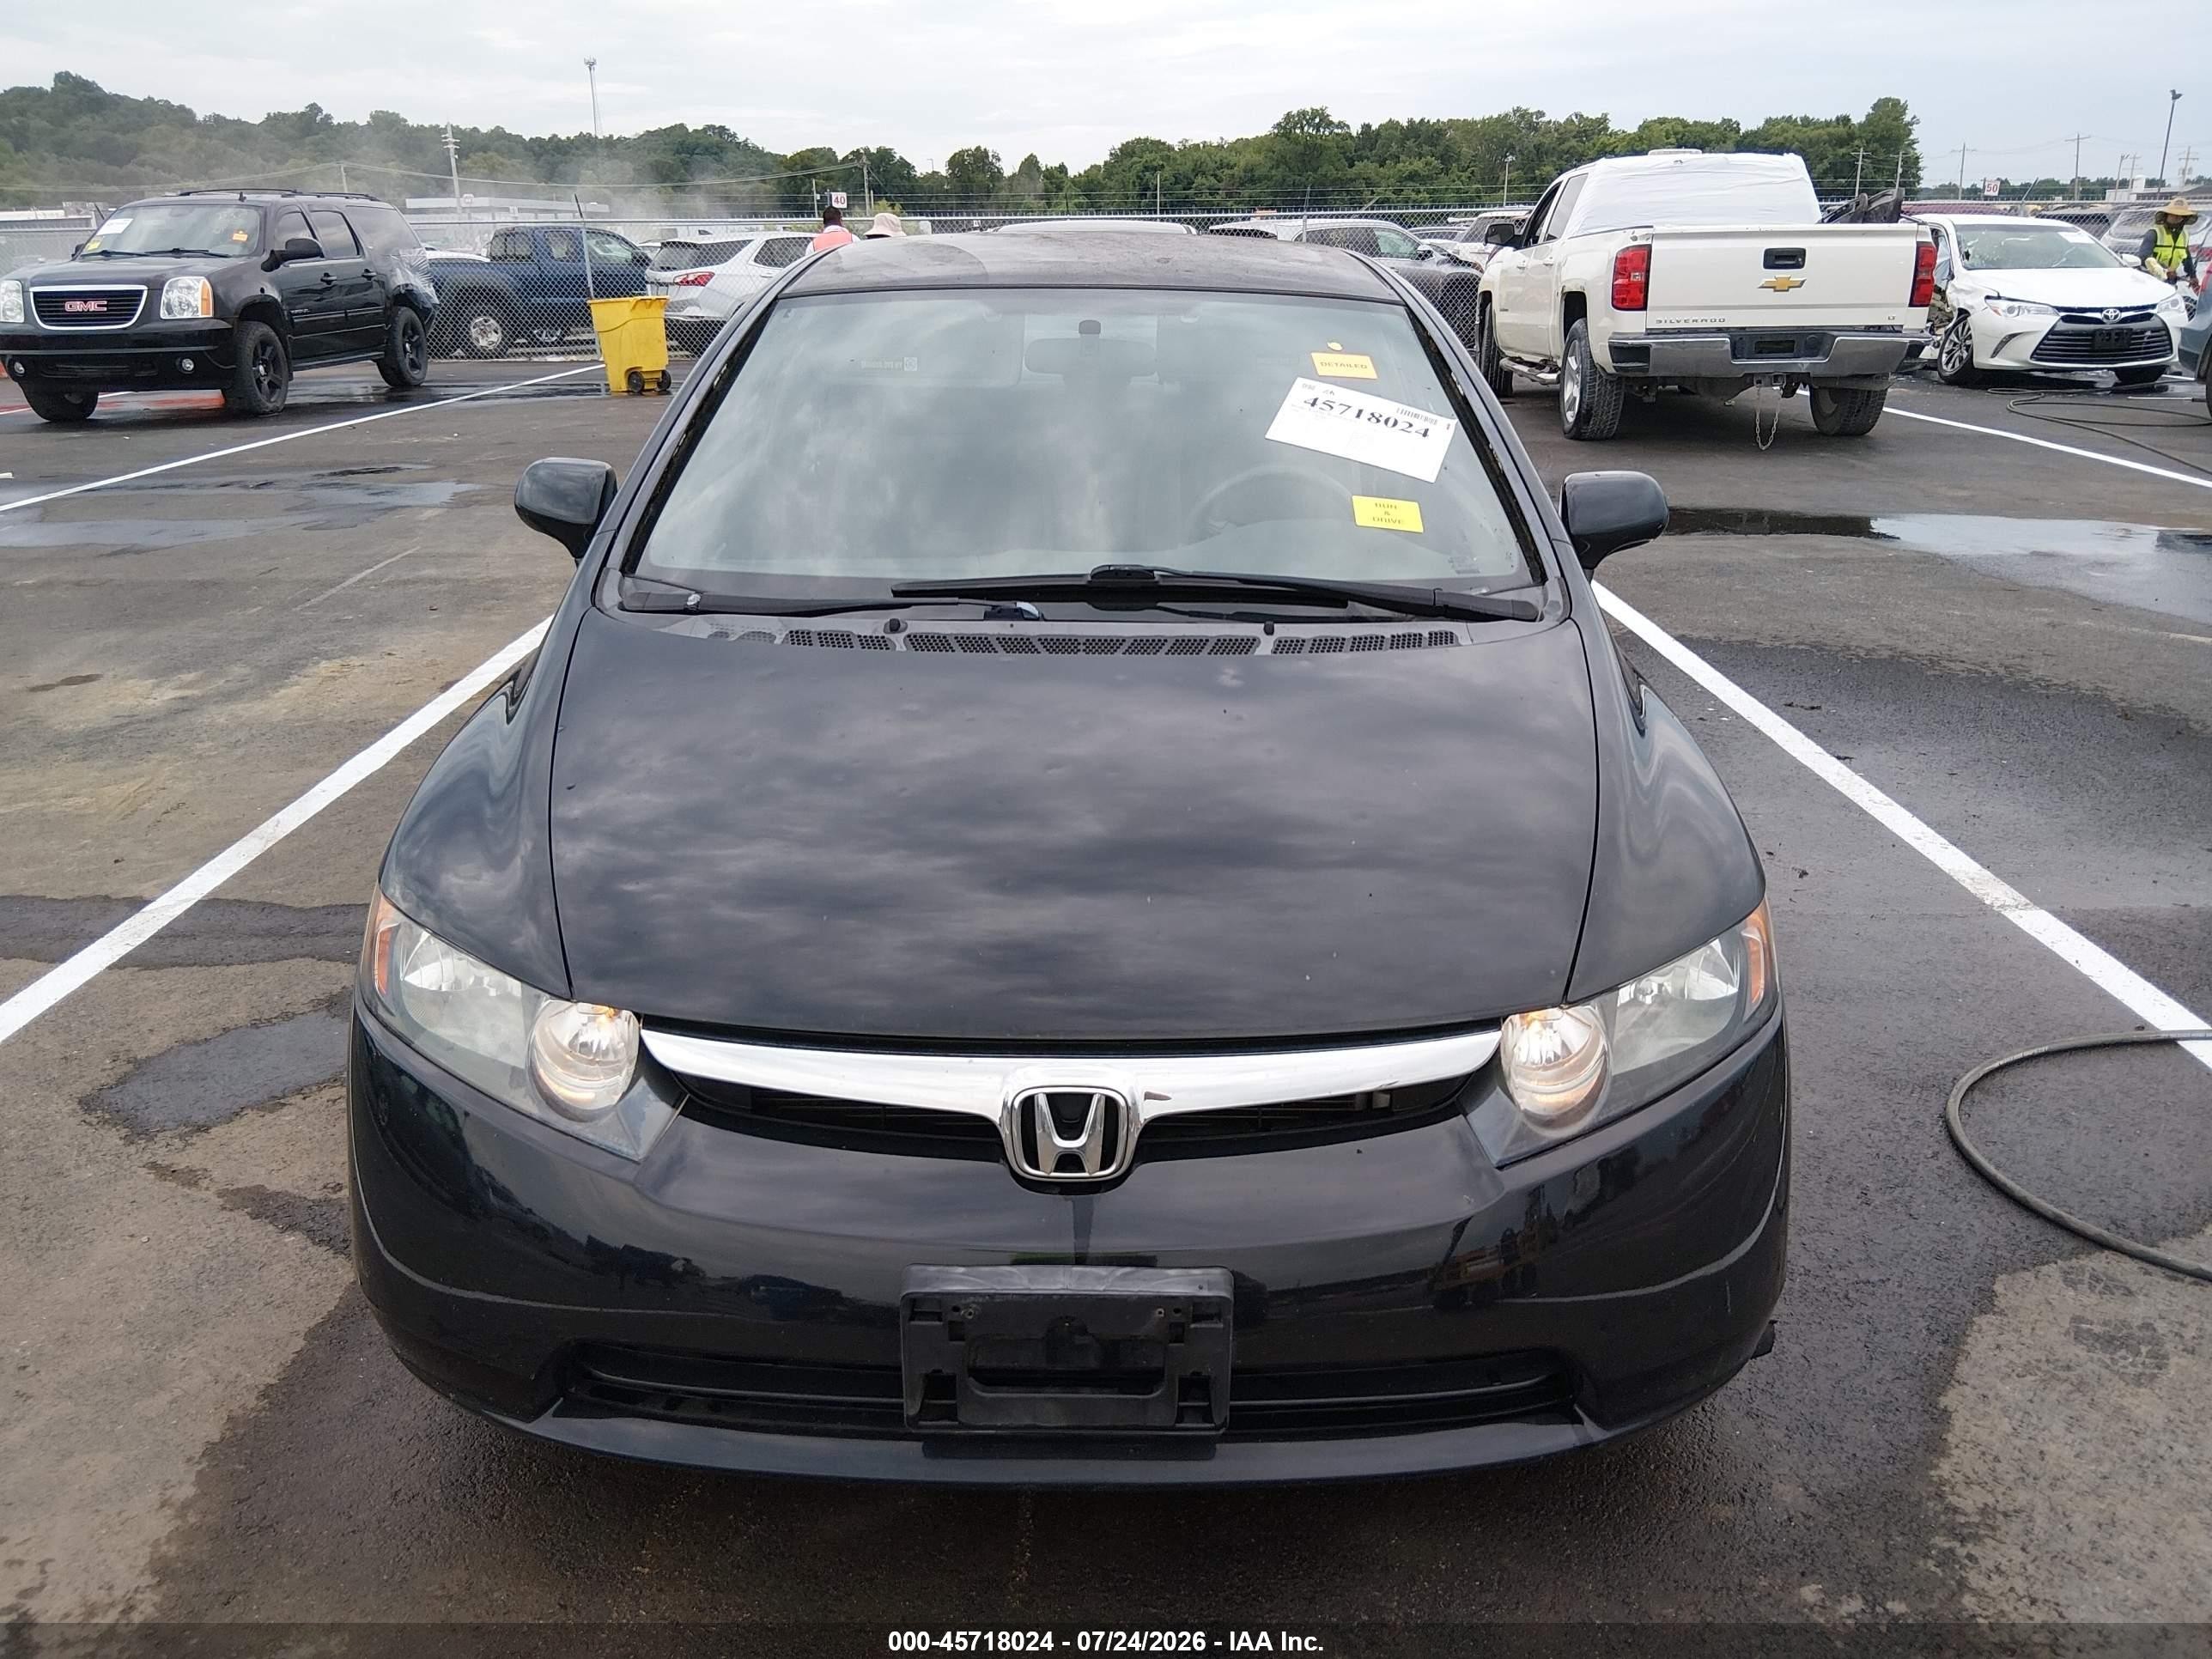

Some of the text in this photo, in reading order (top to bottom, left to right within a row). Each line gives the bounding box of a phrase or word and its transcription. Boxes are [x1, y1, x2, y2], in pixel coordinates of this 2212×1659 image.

[1986, 183, 1998, 193] 50
[834, 196, 846, 205] 40
[64, 301, 107, 312] GMC
[1304, 397, 1430, 438] 45718024
